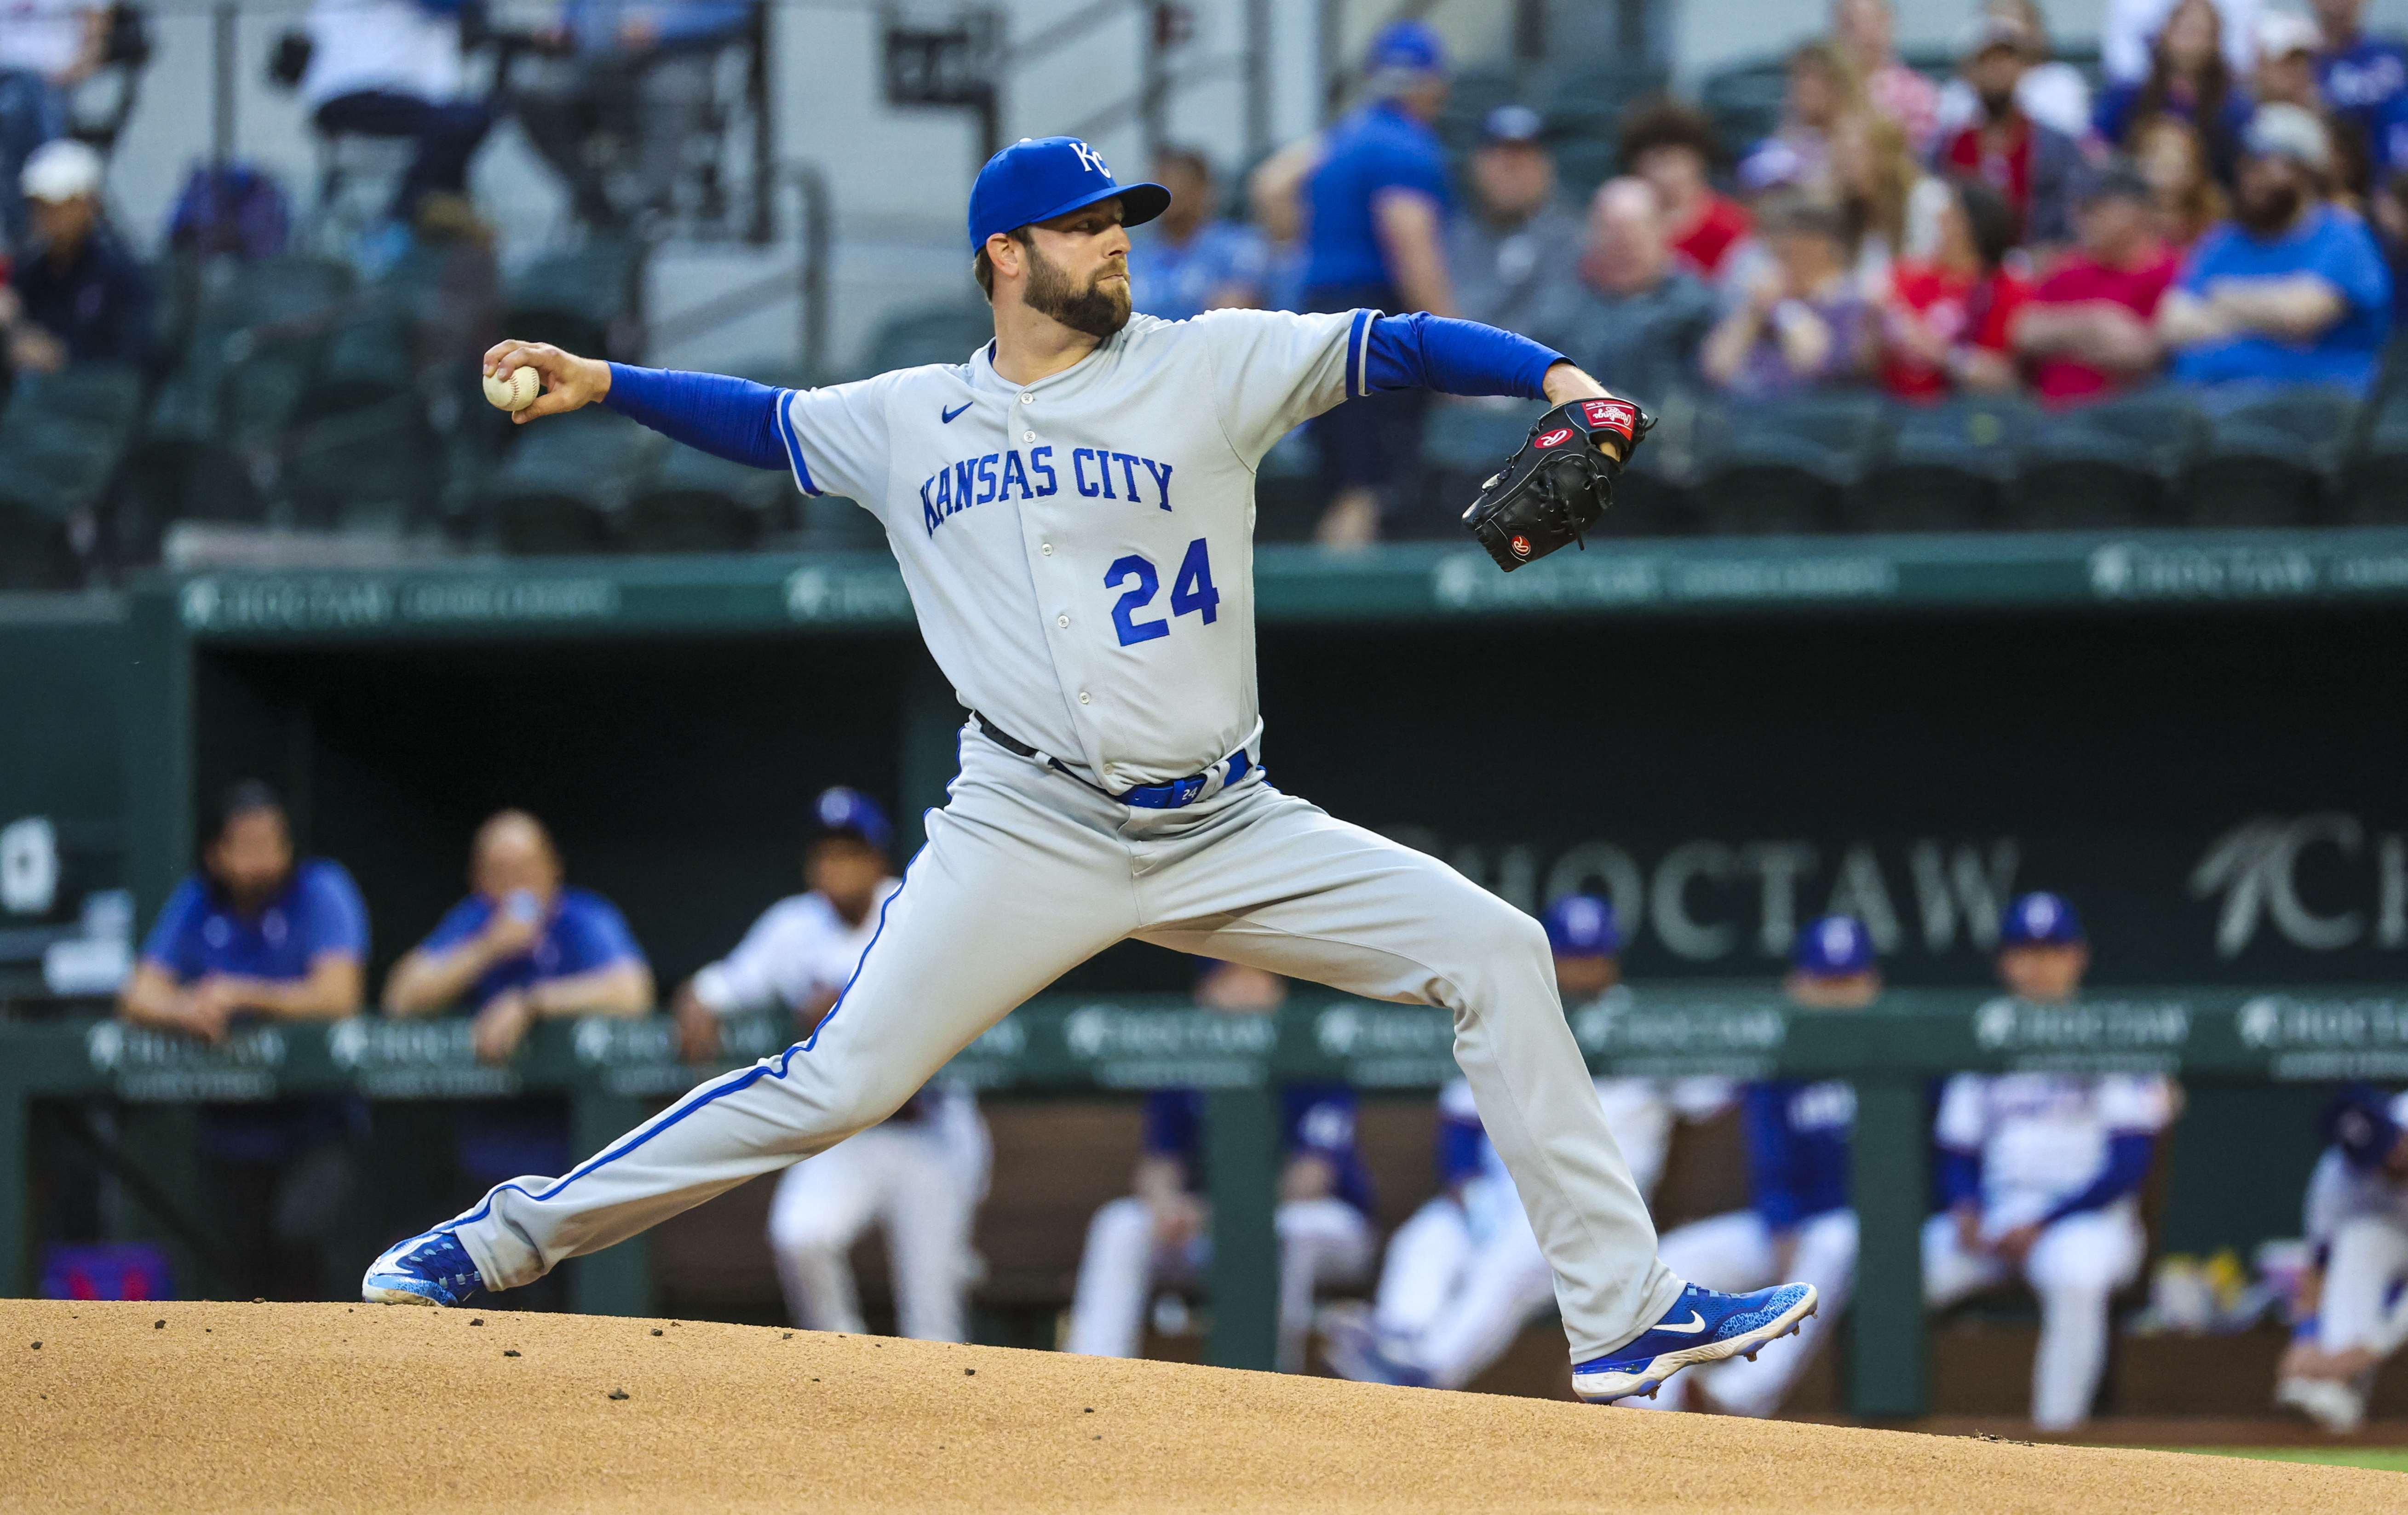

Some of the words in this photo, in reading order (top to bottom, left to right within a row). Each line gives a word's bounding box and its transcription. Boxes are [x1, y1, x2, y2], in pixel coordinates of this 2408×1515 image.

[1069, 143, 1111, 178] KC
[1592, 407, 1631, 426] Rawlings
[920, 445, 1058, 539] KANSAS
[1072, 448, 1173, 512] CITY
[1103, 538, 1220, 647] 24
[1182, 786, 1198, 800] 24
